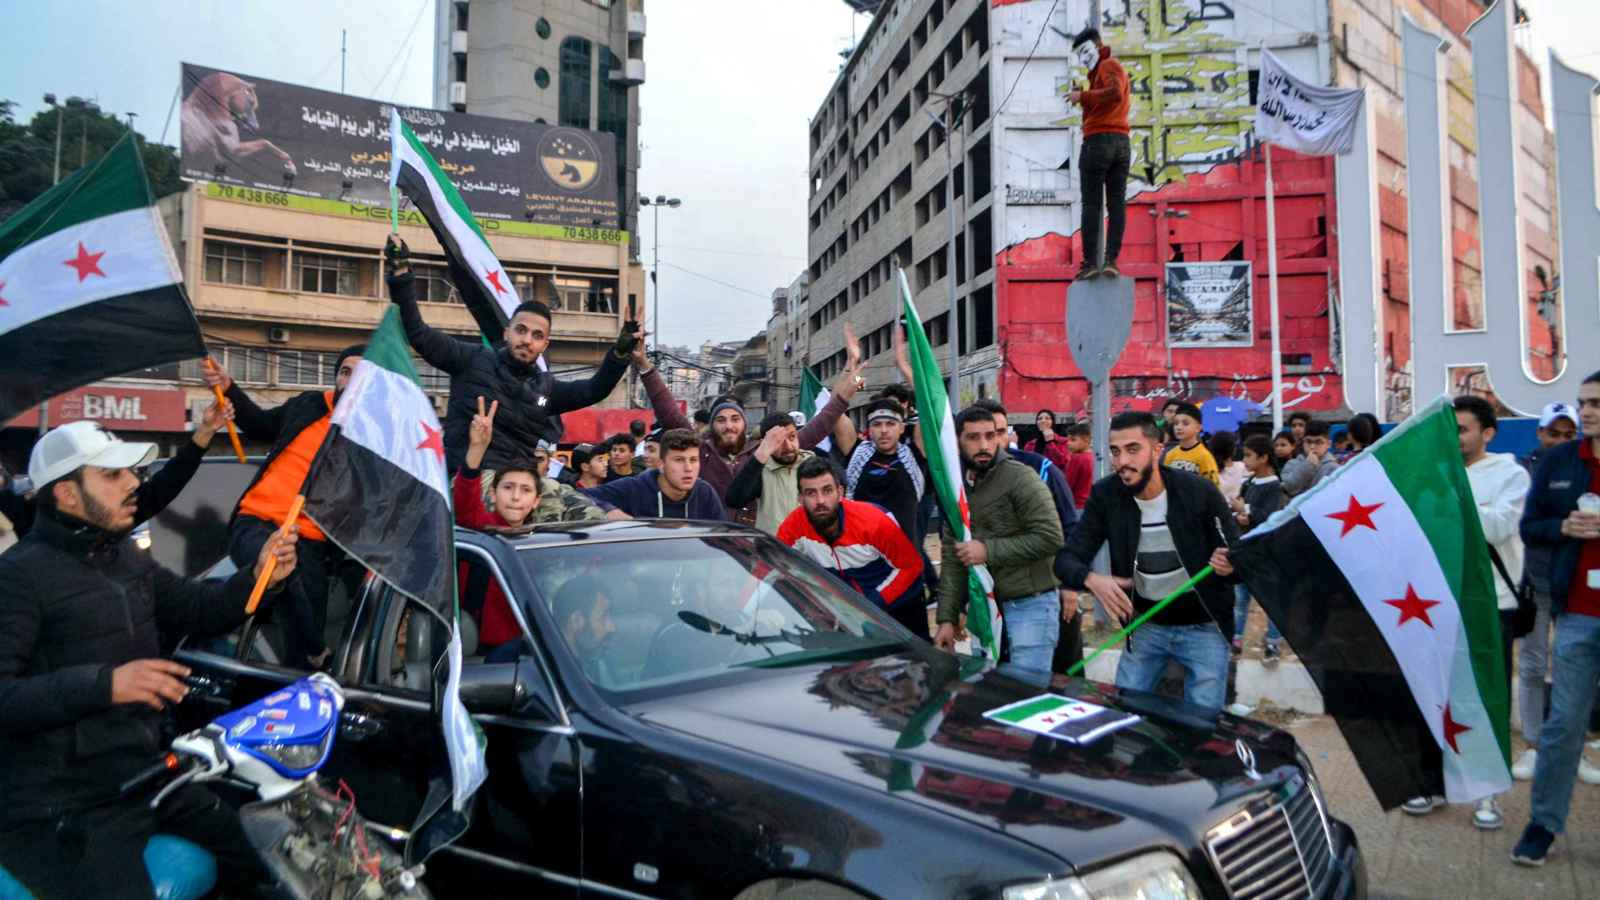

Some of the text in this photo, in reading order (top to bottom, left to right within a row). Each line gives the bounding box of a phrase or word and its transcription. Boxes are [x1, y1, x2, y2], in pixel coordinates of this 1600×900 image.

[217, 184, 233, 198] 70
[238, 188, 263, 203] 438
[264, 191, 289, 206] 666
[562, 226, 621, 242] 70 438 666
[83, 394, 147, 420] BML
